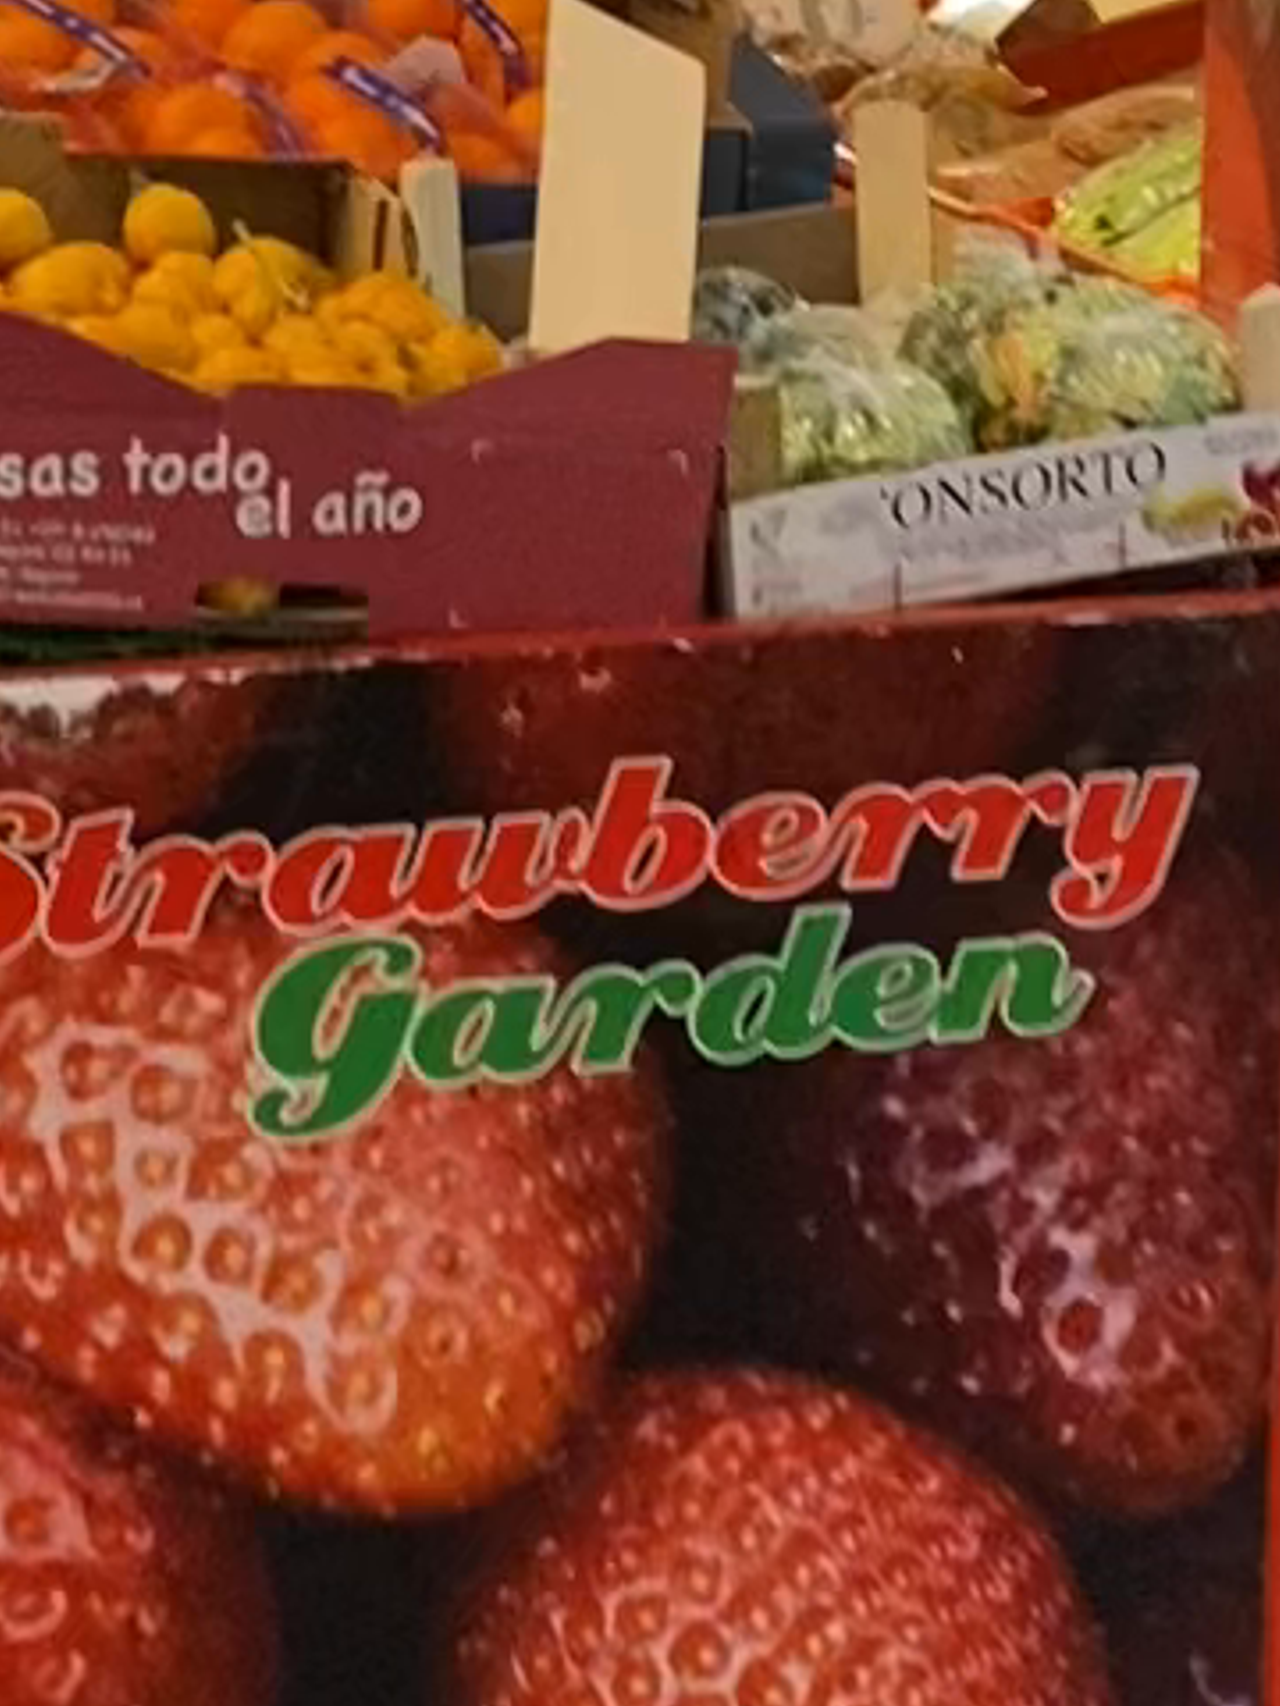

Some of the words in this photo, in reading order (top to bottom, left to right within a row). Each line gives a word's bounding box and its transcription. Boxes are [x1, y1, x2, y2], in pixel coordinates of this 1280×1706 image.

[122, 434, 270, 495] todo
[880, 440, 1168, 530] ONSORTO
[235, 479, 290, 540] el
[312, 471, 423, 536] año
[242, 903, 1094, 1138] Garden
